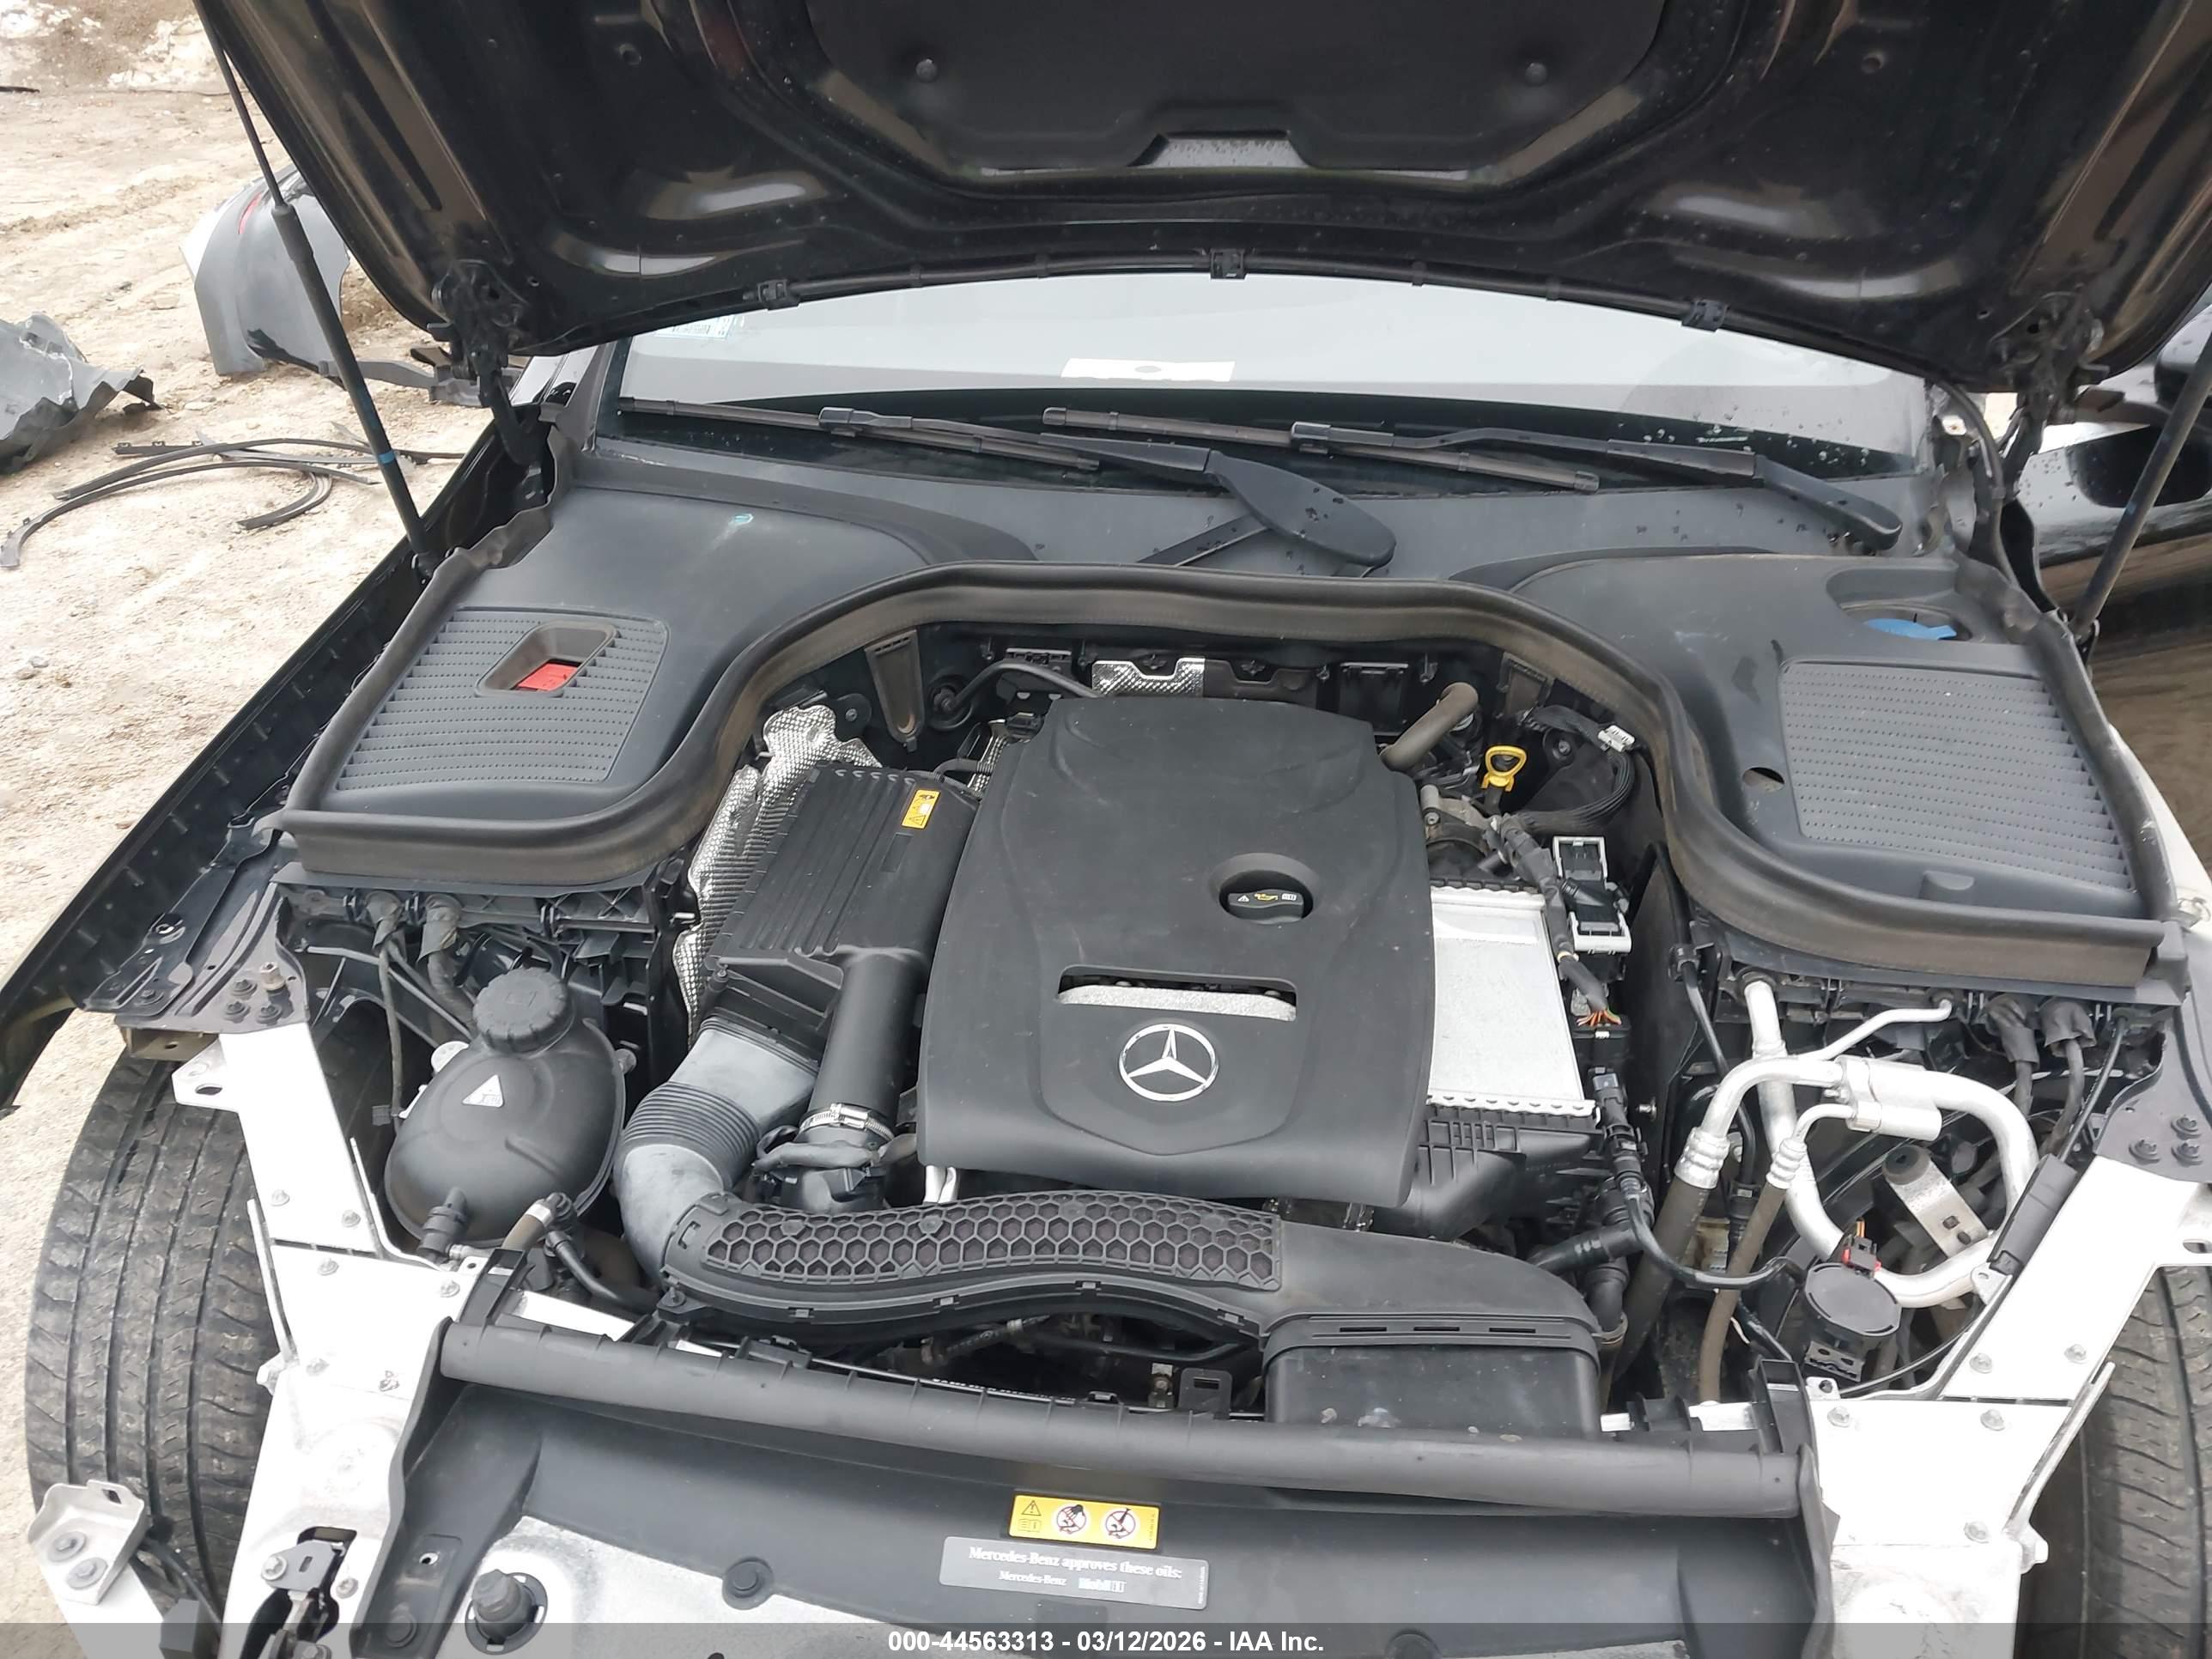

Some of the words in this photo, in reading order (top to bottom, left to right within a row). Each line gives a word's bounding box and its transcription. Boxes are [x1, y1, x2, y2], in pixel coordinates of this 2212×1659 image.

[969, 1547, 1060, 1566] Mercedes-Benz
[1061, 1558, 1118, 1571] approves
[1119, 1561, 1154, 1576] these
[1156, 1565, 1182, 1579] oils:
[998, 1570, 1066, 1586] Mercedes-Benz
